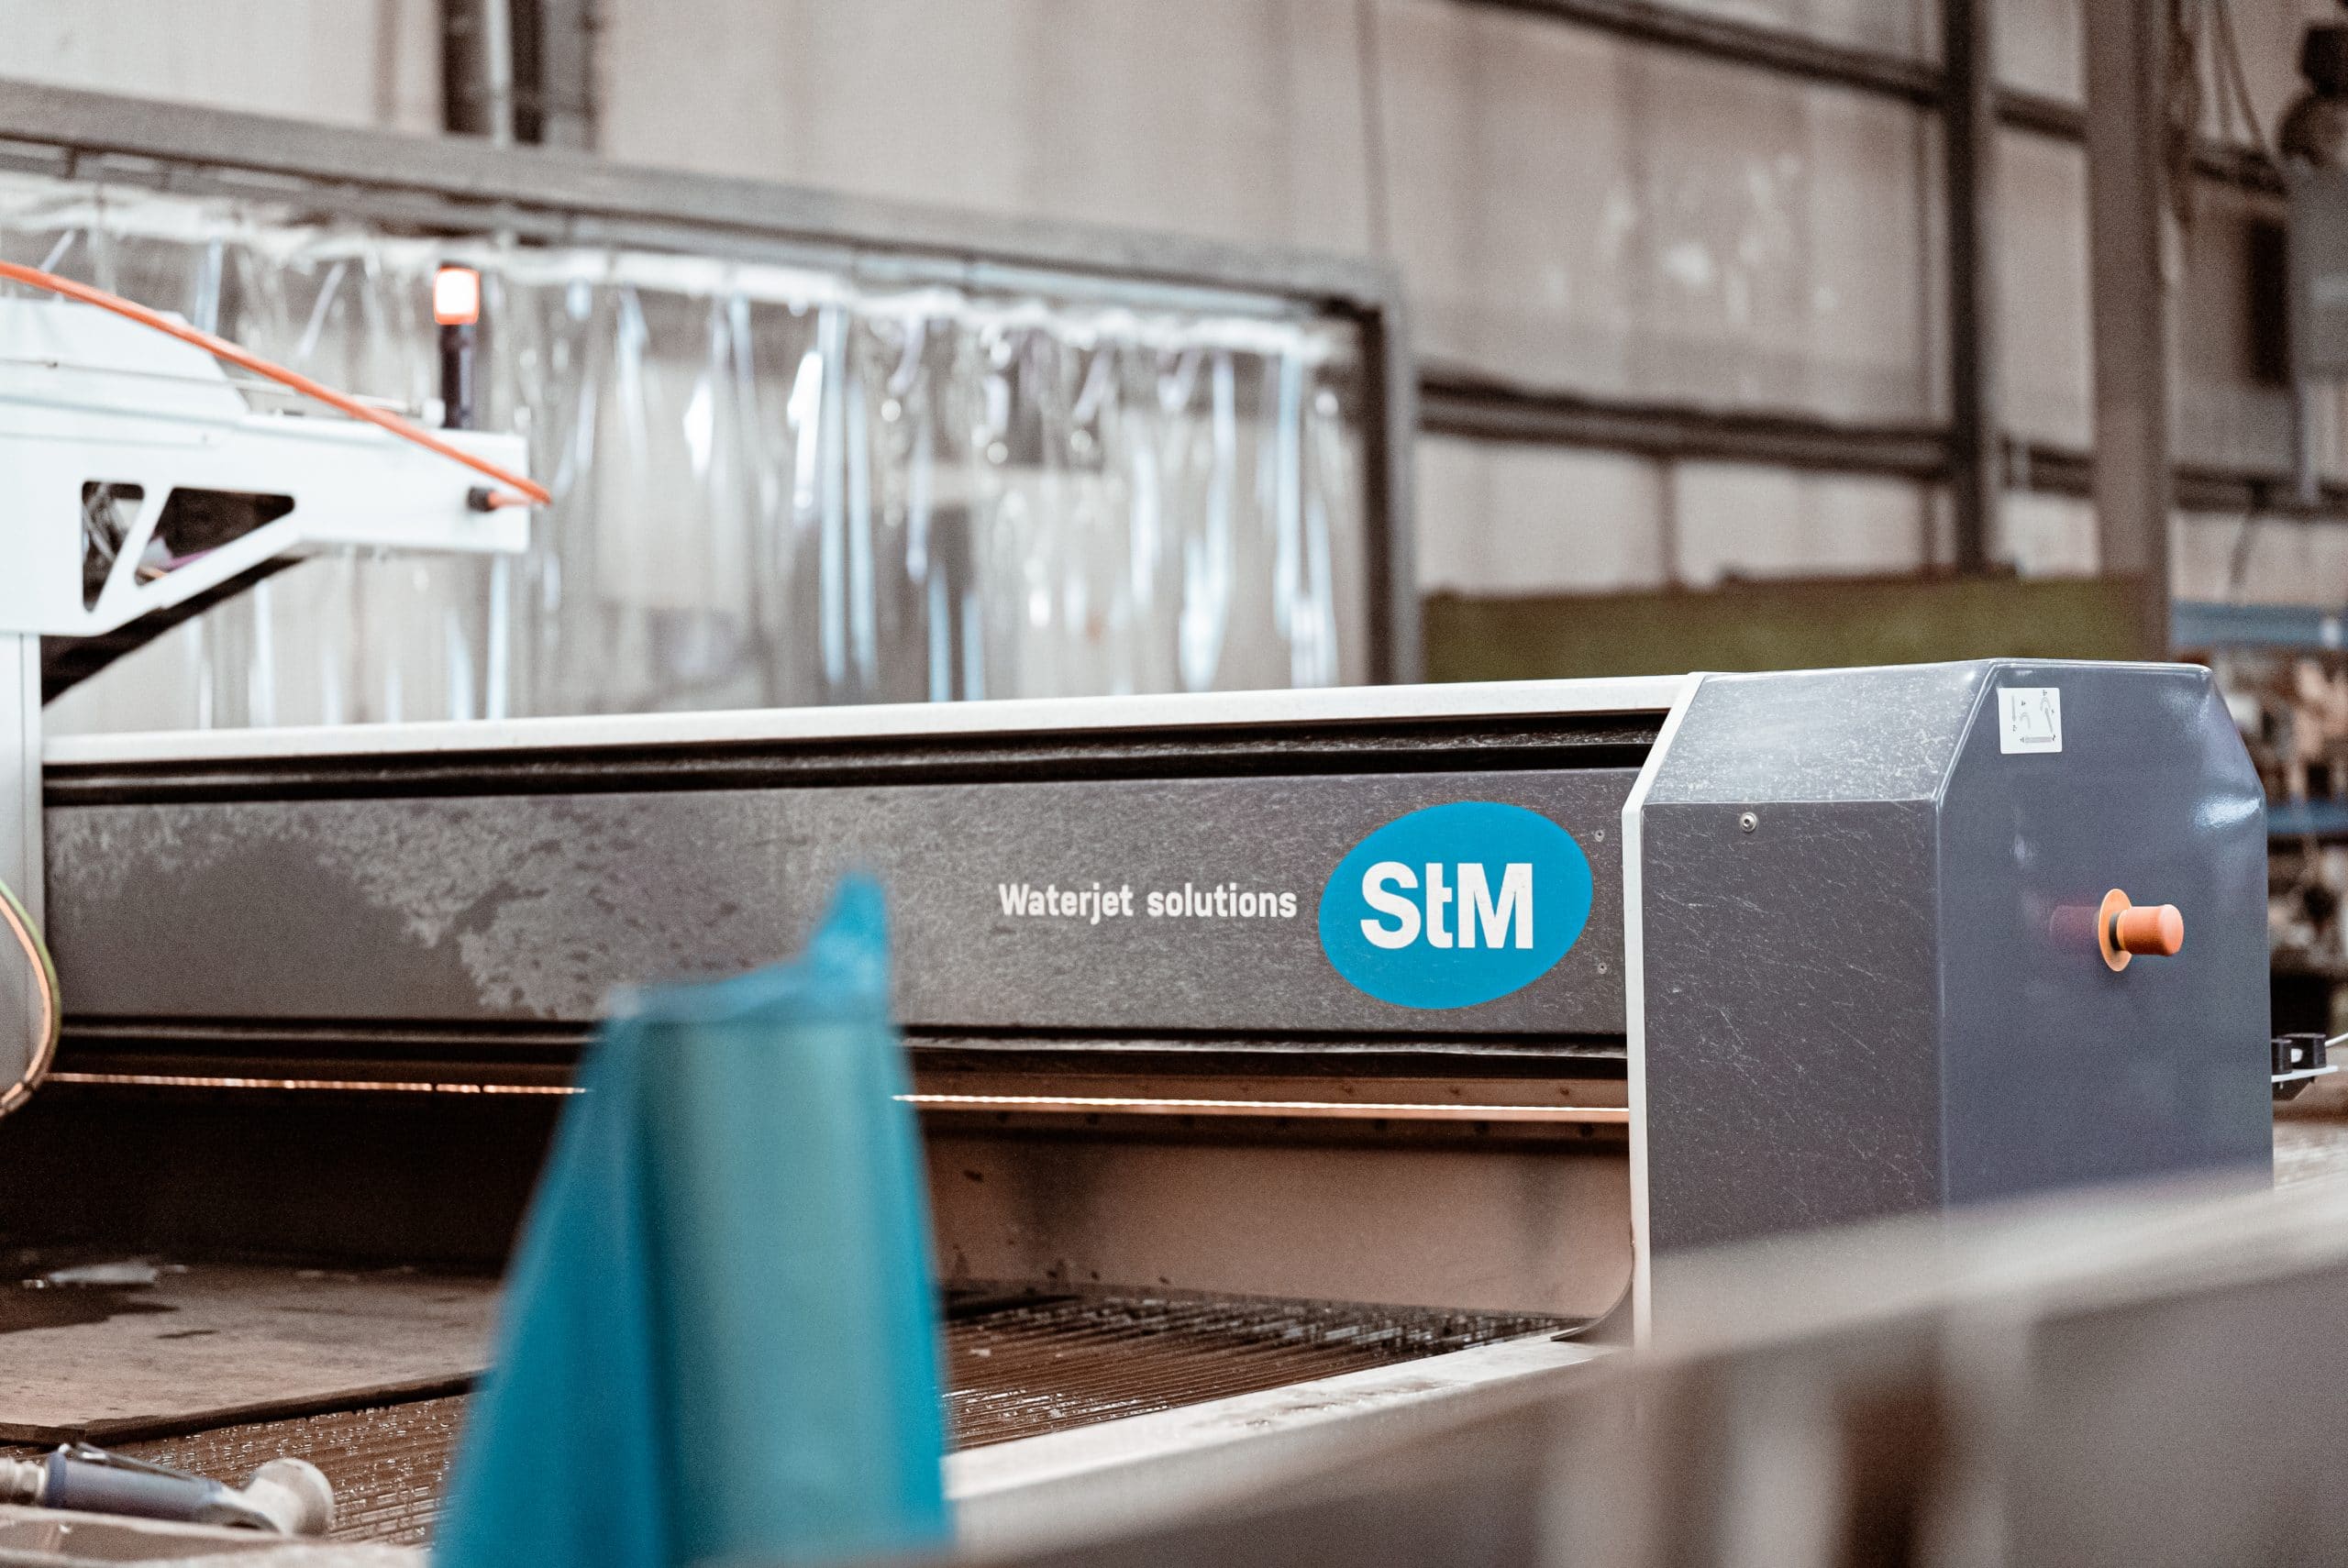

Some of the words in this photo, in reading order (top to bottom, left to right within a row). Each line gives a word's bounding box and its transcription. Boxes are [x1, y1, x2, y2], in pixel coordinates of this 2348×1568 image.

[998, 881, 1135, 926] Waterjet
[1147, 882, 1298, 920] solutions
[1360, 861, 1534, 949] StM
